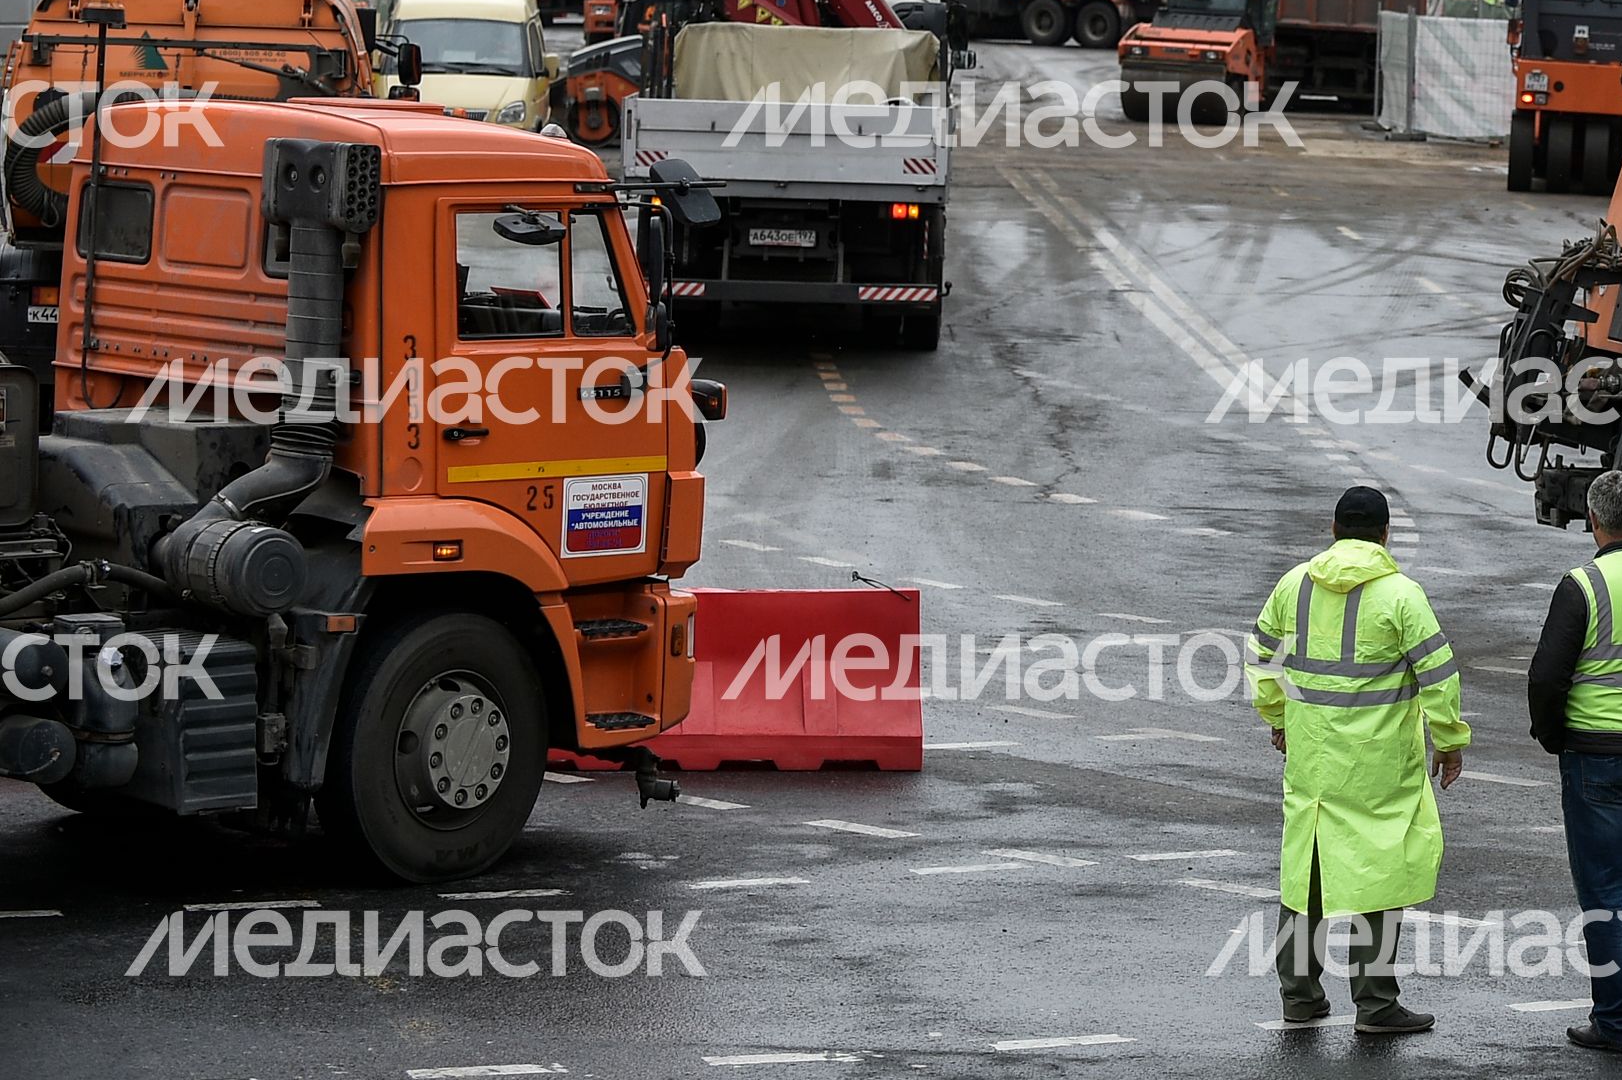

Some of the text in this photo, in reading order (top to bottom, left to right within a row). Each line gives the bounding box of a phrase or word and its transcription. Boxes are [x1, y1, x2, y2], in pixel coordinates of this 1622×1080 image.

[581, 388, 622, 399] 65115
[591, 482, 622, 491] МОСКВА
[526, 485, 555, 511] 25
[572, 490, 640, 502] ГОСУДАРСТВЕННОЕ
[581, 510, 630, 520] УЧРЕЖДЕНИЕ
